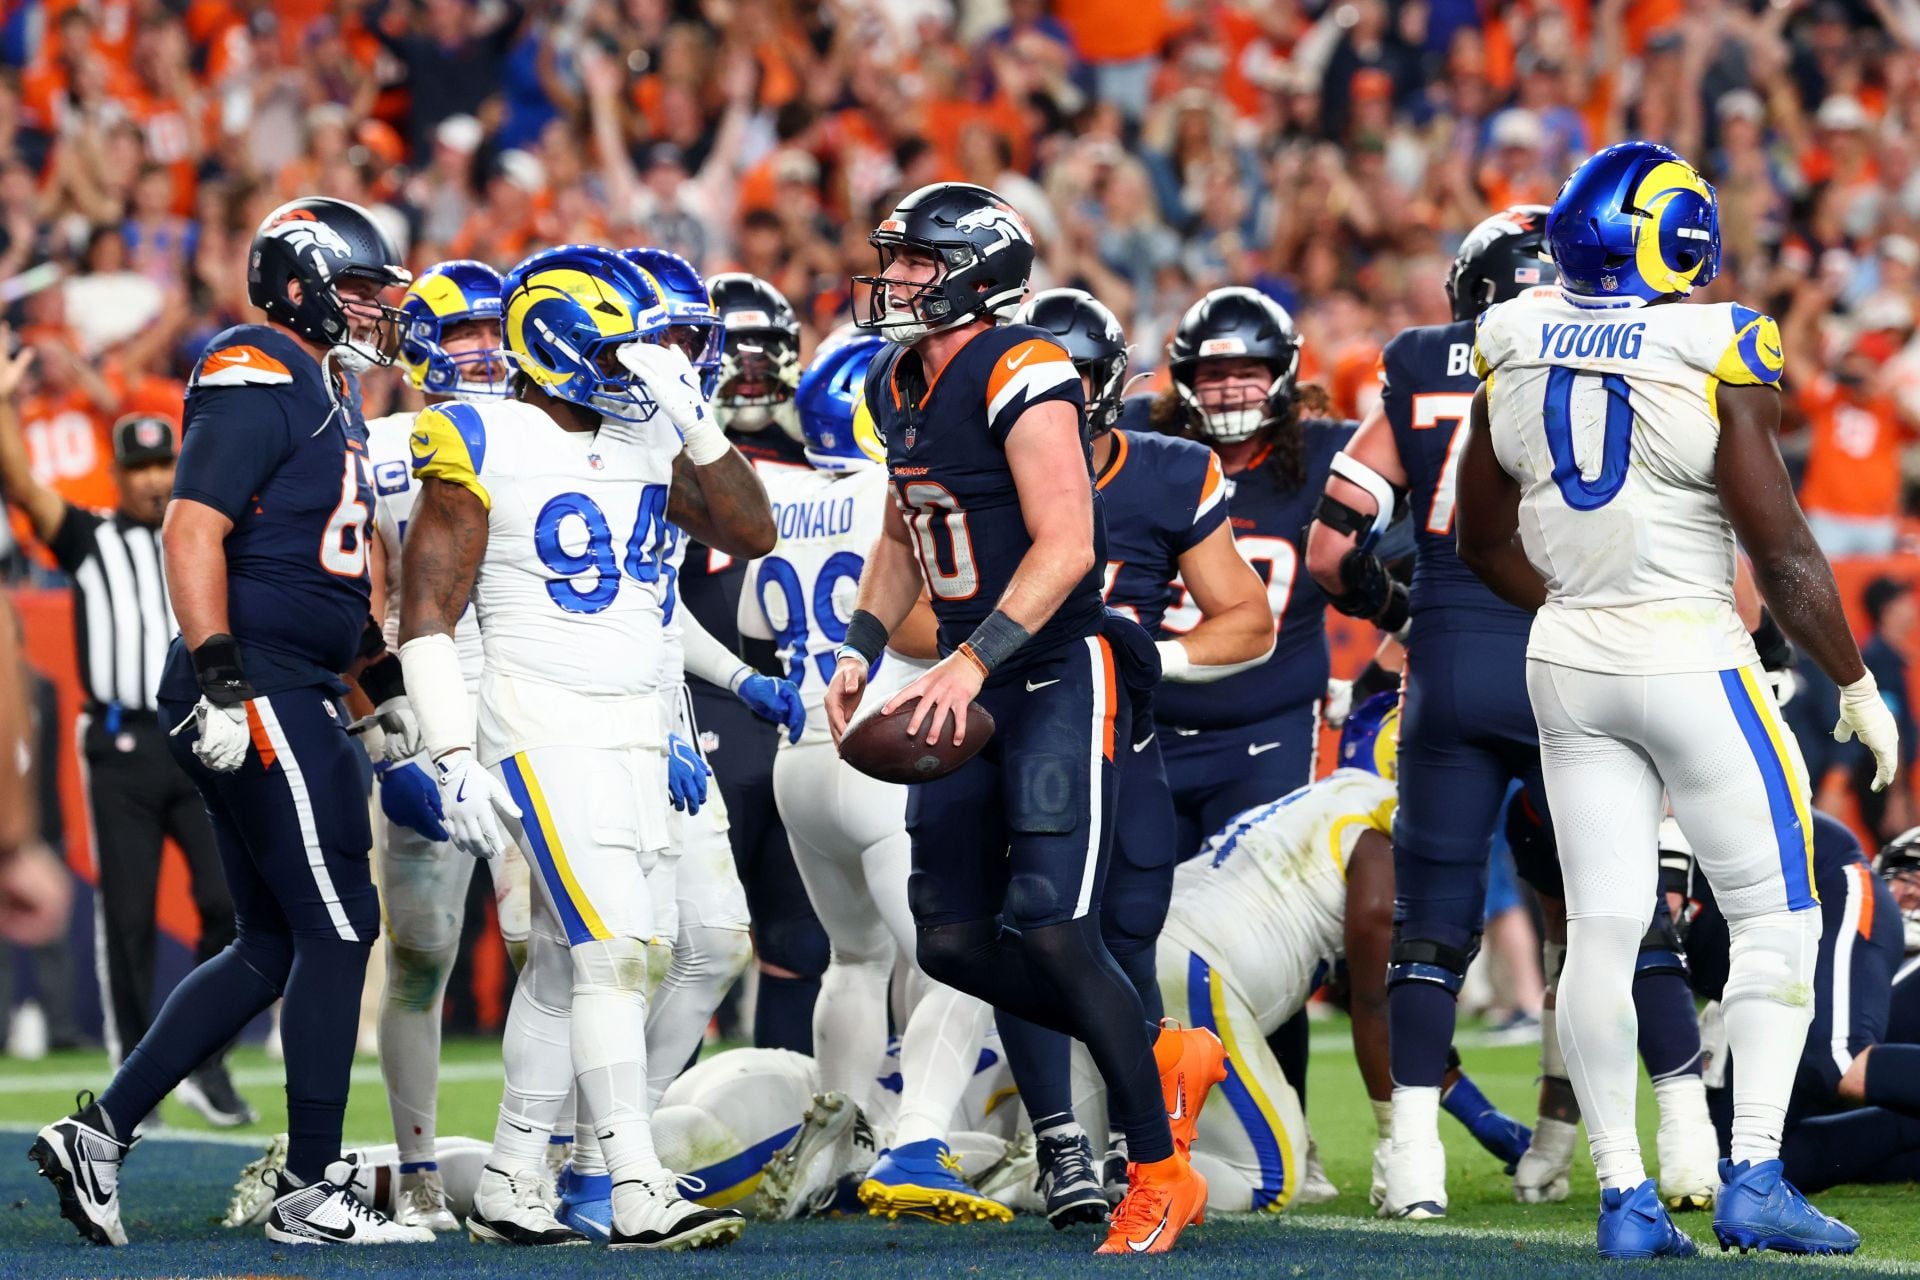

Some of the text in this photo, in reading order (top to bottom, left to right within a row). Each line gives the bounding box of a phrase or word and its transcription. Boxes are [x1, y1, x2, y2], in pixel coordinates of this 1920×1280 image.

[1538, 322, 1646, 360] YOUNG
[1411, 392, 1474, 536] 7
[1543, 364, 1634, 512] 0
[319, 449, 373, 578] 6
[534, 484, 668, 615] 94
[756, 551, 884, 690] 99
